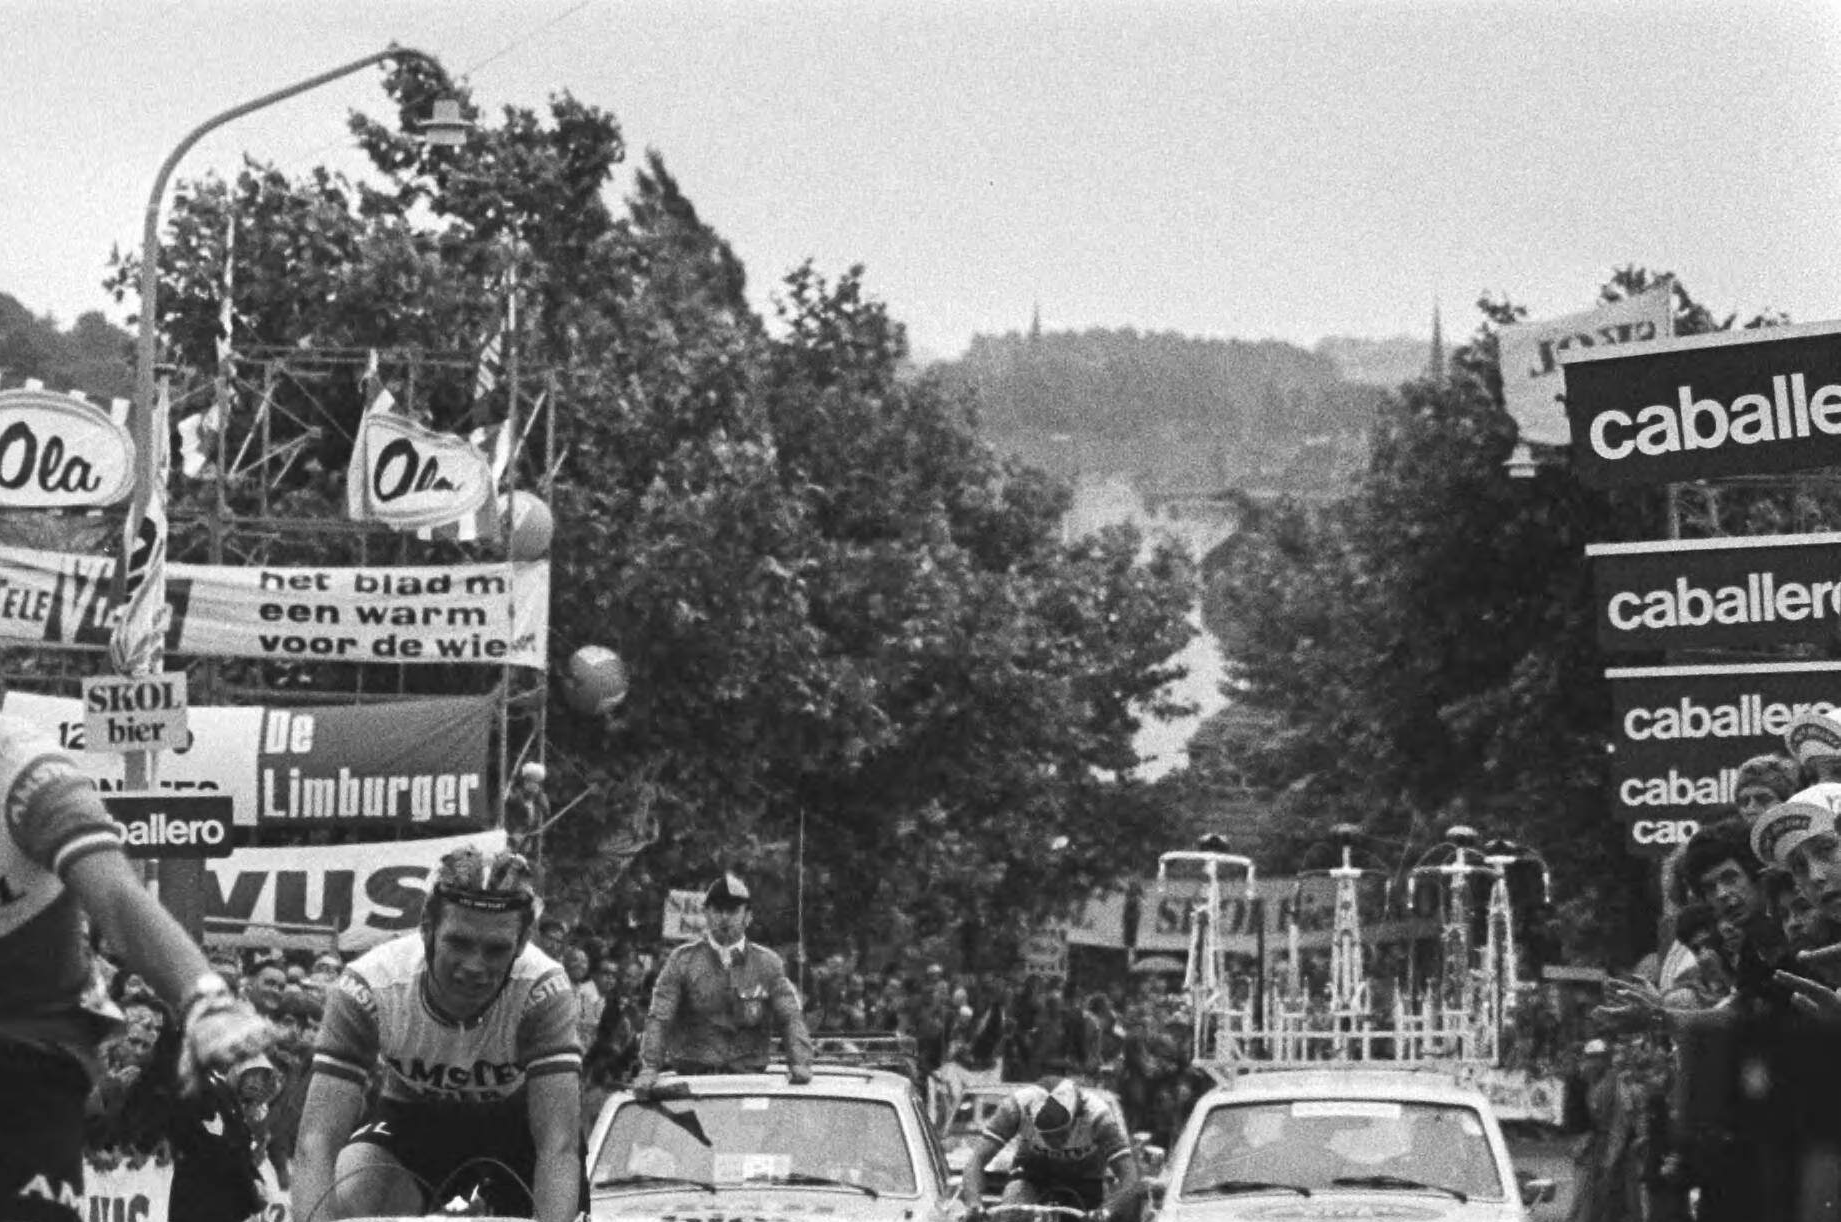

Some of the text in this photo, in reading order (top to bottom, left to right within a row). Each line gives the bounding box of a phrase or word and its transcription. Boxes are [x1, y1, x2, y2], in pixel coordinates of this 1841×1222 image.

[354, 573, 452, 595] blad
[259, 603, 487, 626] een warm
[1608, 571, 1841, 630] caballer
[259, 634, 357, 655] voor
[371, 633, 423, 657] de
[88, 683, 182, 713] SKOL
[109, 717, 165, 744] bier
[264, 709, 315, 754] De
[263, 767, 480, 822] Limburger
